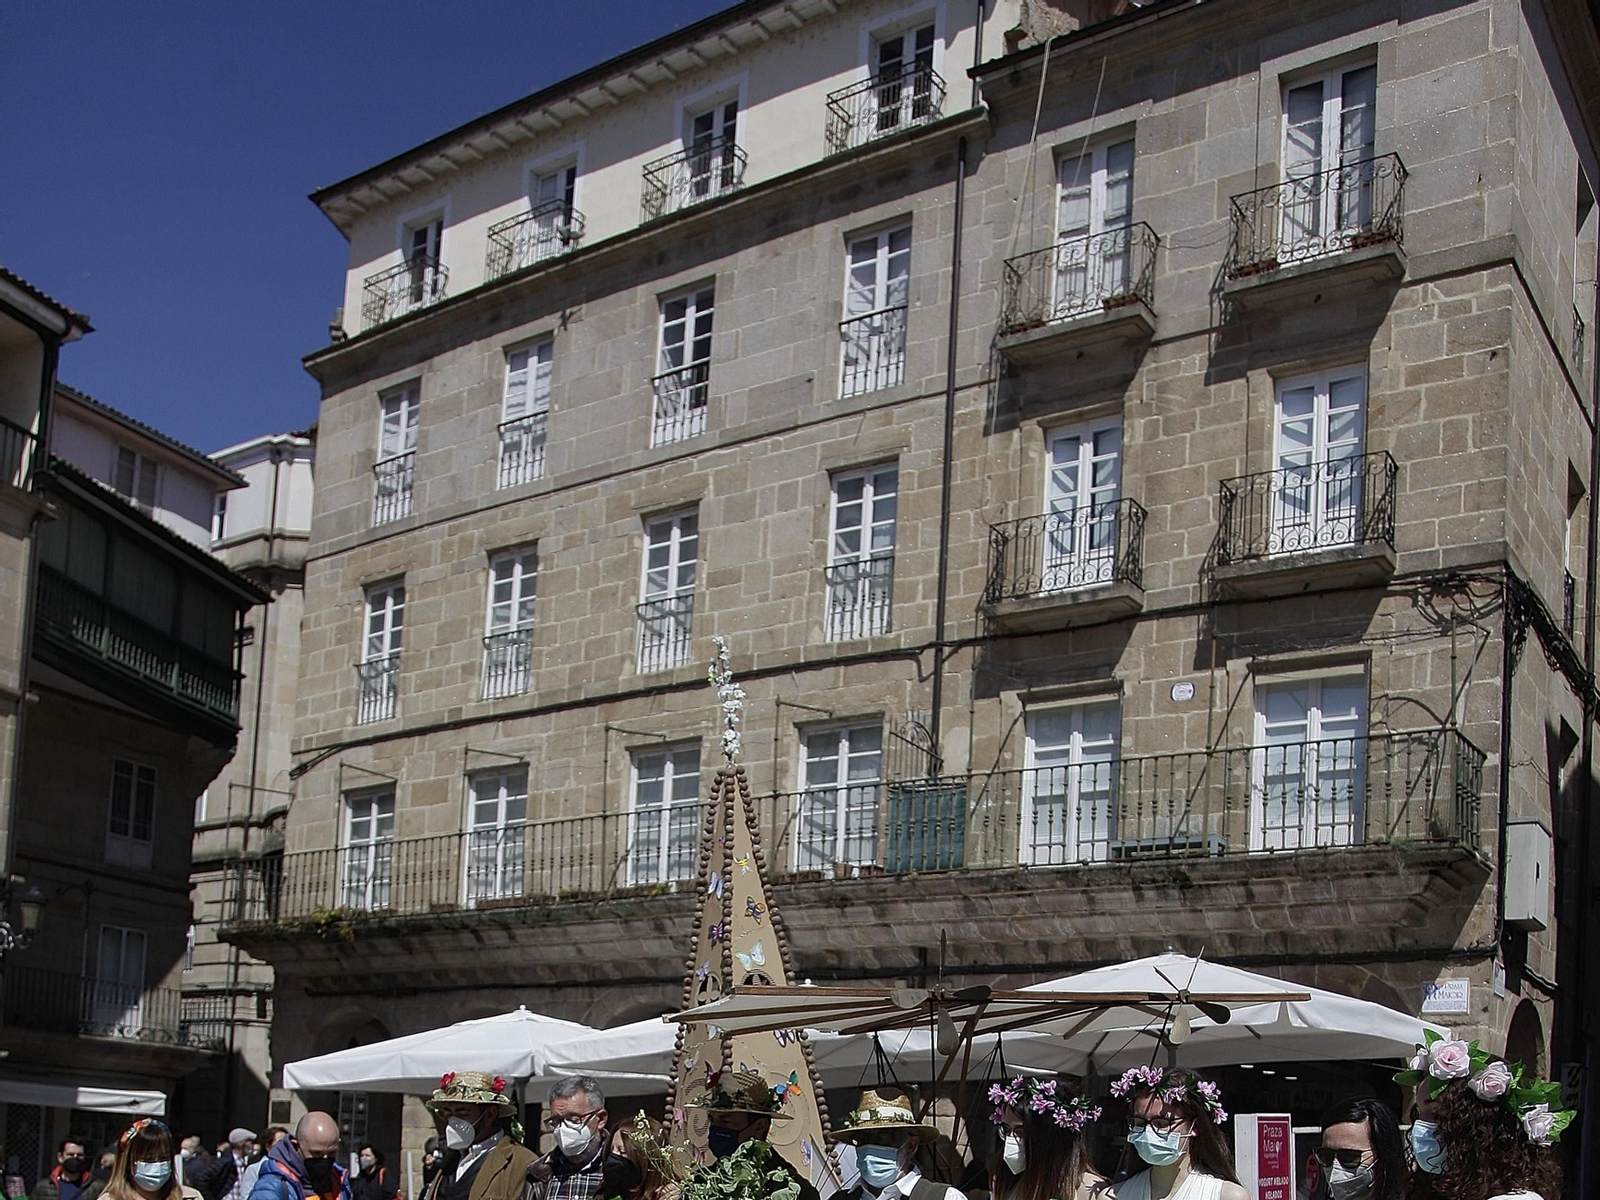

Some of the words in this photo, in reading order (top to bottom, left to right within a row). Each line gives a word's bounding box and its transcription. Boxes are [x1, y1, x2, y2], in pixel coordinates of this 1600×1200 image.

[1263, 1124, 1282, 1137] Praza
[1263, 1139, 1283, 1152] Maior
[1265, 1190, 1283, 1200] HELADOS
